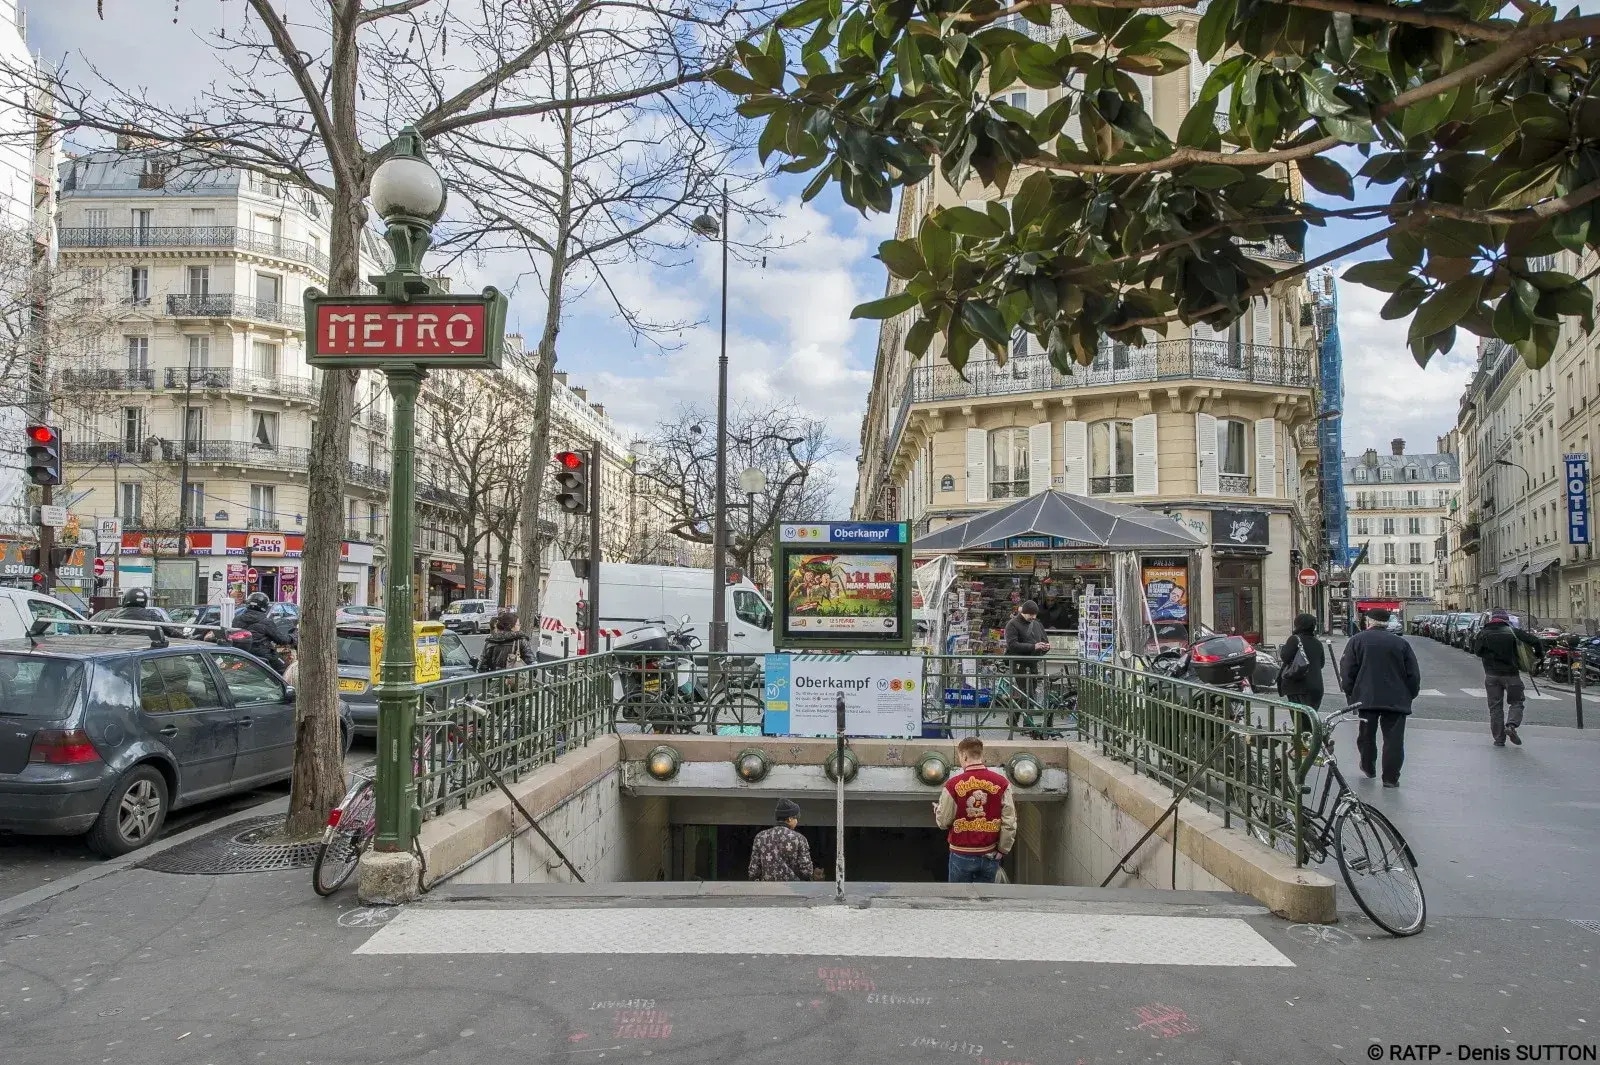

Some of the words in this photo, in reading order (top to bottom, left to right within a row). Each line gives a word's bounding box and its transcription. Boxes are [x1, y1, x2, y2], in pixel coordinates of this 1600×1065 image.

[328, 313, 474, 348] METRO
[1569, 463, 1584, 542] HOTEL
[834, 528, 890, 540] Oberkampf
[1017, 539, 1045, 548] Parisien
[795, 676, 871, 691] Oberkampf
